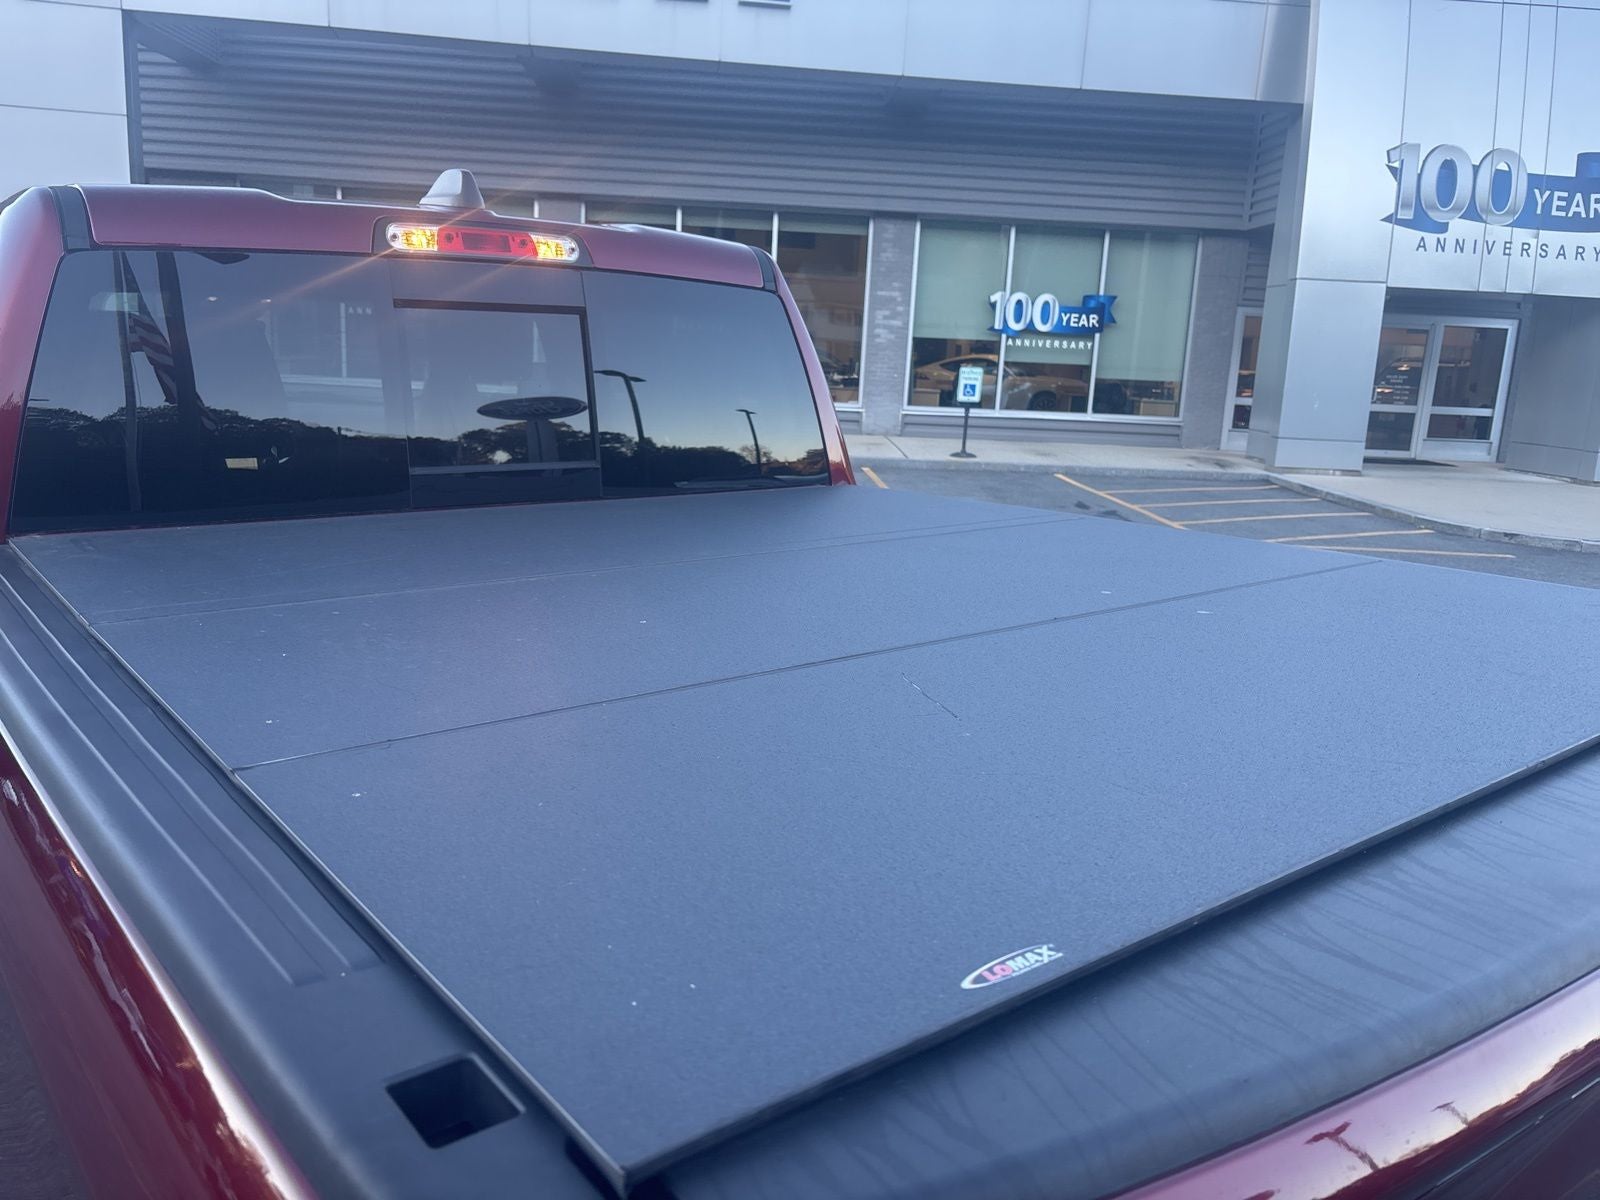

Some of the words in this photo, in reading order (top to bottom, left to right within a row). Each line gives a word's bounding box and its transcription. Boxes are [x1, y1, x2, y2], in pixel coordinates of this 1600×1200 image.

[1386, 142, 1528, 225] 100
[990, 291, 1059, 332] 100
[1061, 313, 1099, 327] YEAR
[1007, 338, 1093, 349] ANNIVERSARY
[980, 945, 1057, 982] LOMAX
